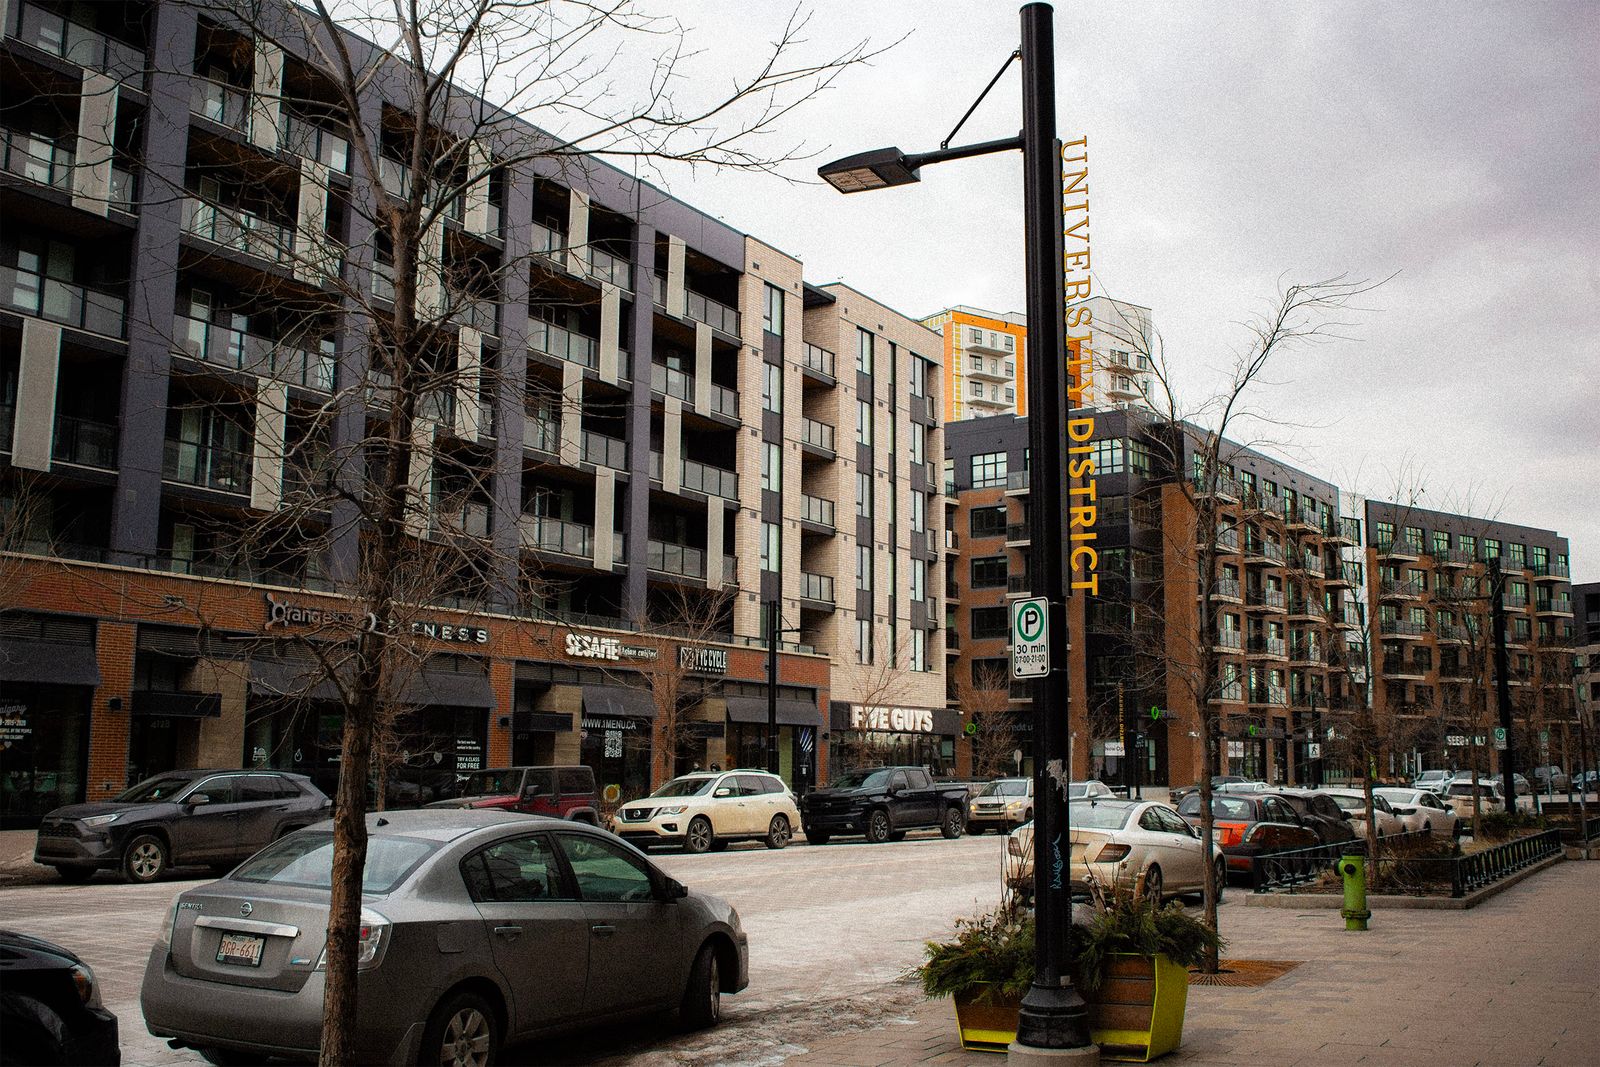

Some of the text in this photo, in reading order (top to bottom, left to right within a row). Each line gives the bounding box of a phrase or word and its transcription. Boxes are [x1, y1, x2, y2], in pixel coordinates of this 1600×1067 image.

[1061, 135, 1099, 596] UNIVERSITY DISTRICT
[1025, 610, 1038, 634] P
[709, 649, 727, 669] CYCLE
[1016, 643, 1046, 655] 30 min
[891, 706, 933, 732] GUYS
[456, 762, 480, 770] FOR FREE
